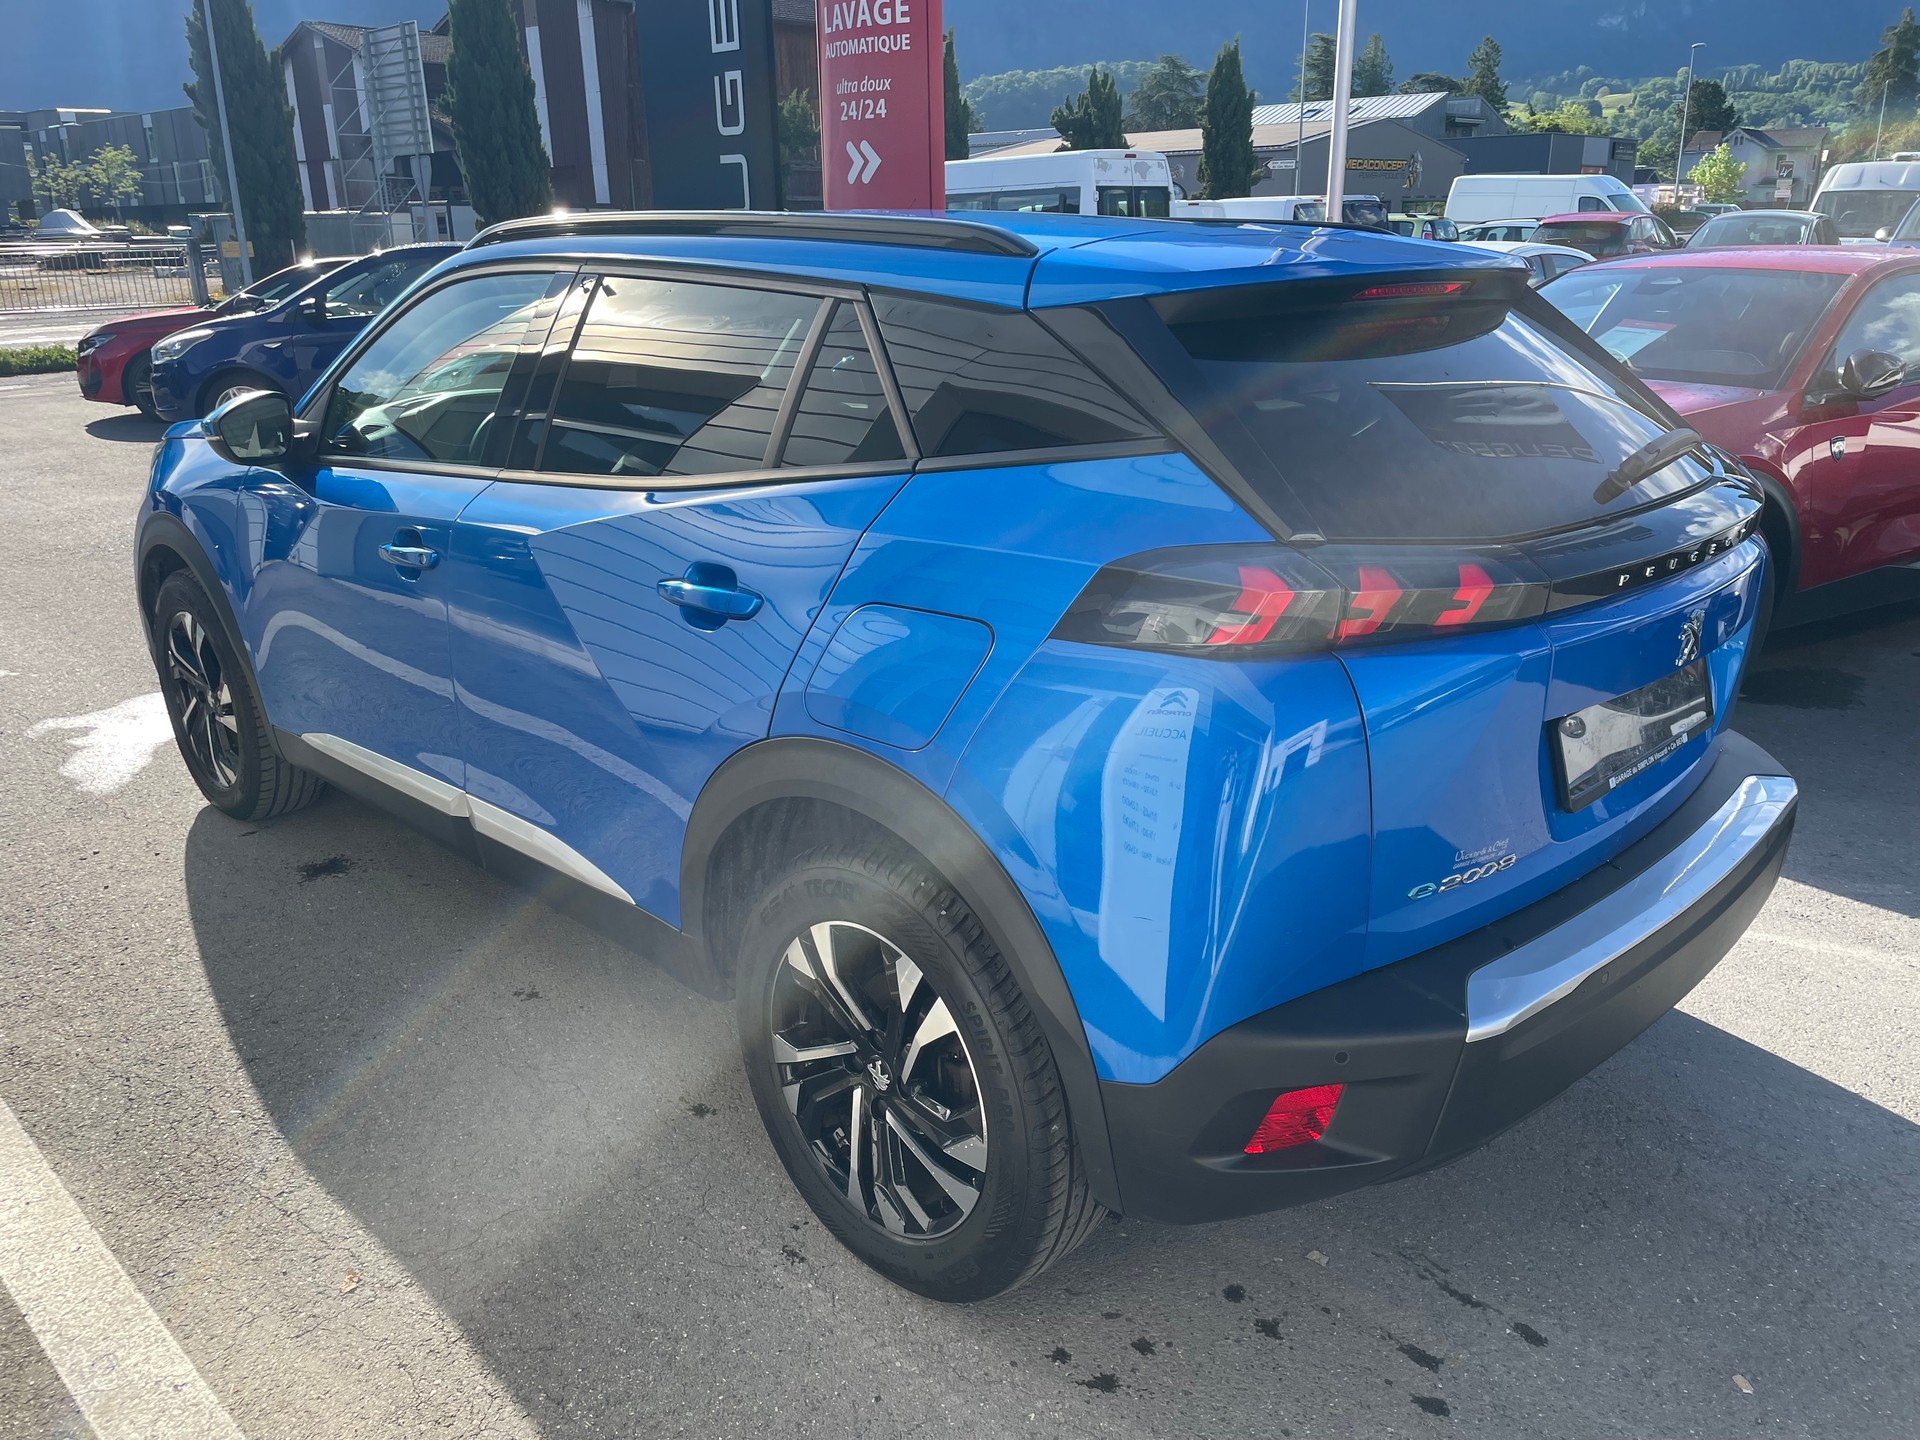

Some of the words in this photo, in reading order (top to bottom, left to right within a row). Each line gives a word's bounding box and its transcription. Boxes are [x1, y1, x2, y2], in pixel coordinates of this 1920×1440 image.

[823, 0, 911, 34] LAVAGE
[825, 33, 911, 59] AUTOMATIQUE
[836, 78, 858, 95] ultra
[860, 75, 892, 92] doux
[840, 98, 887, 121] 24/24
[1618, 528, 1746, 586] PEUGEOT
[962, 1001, 1004, 1075] SPIRIT
